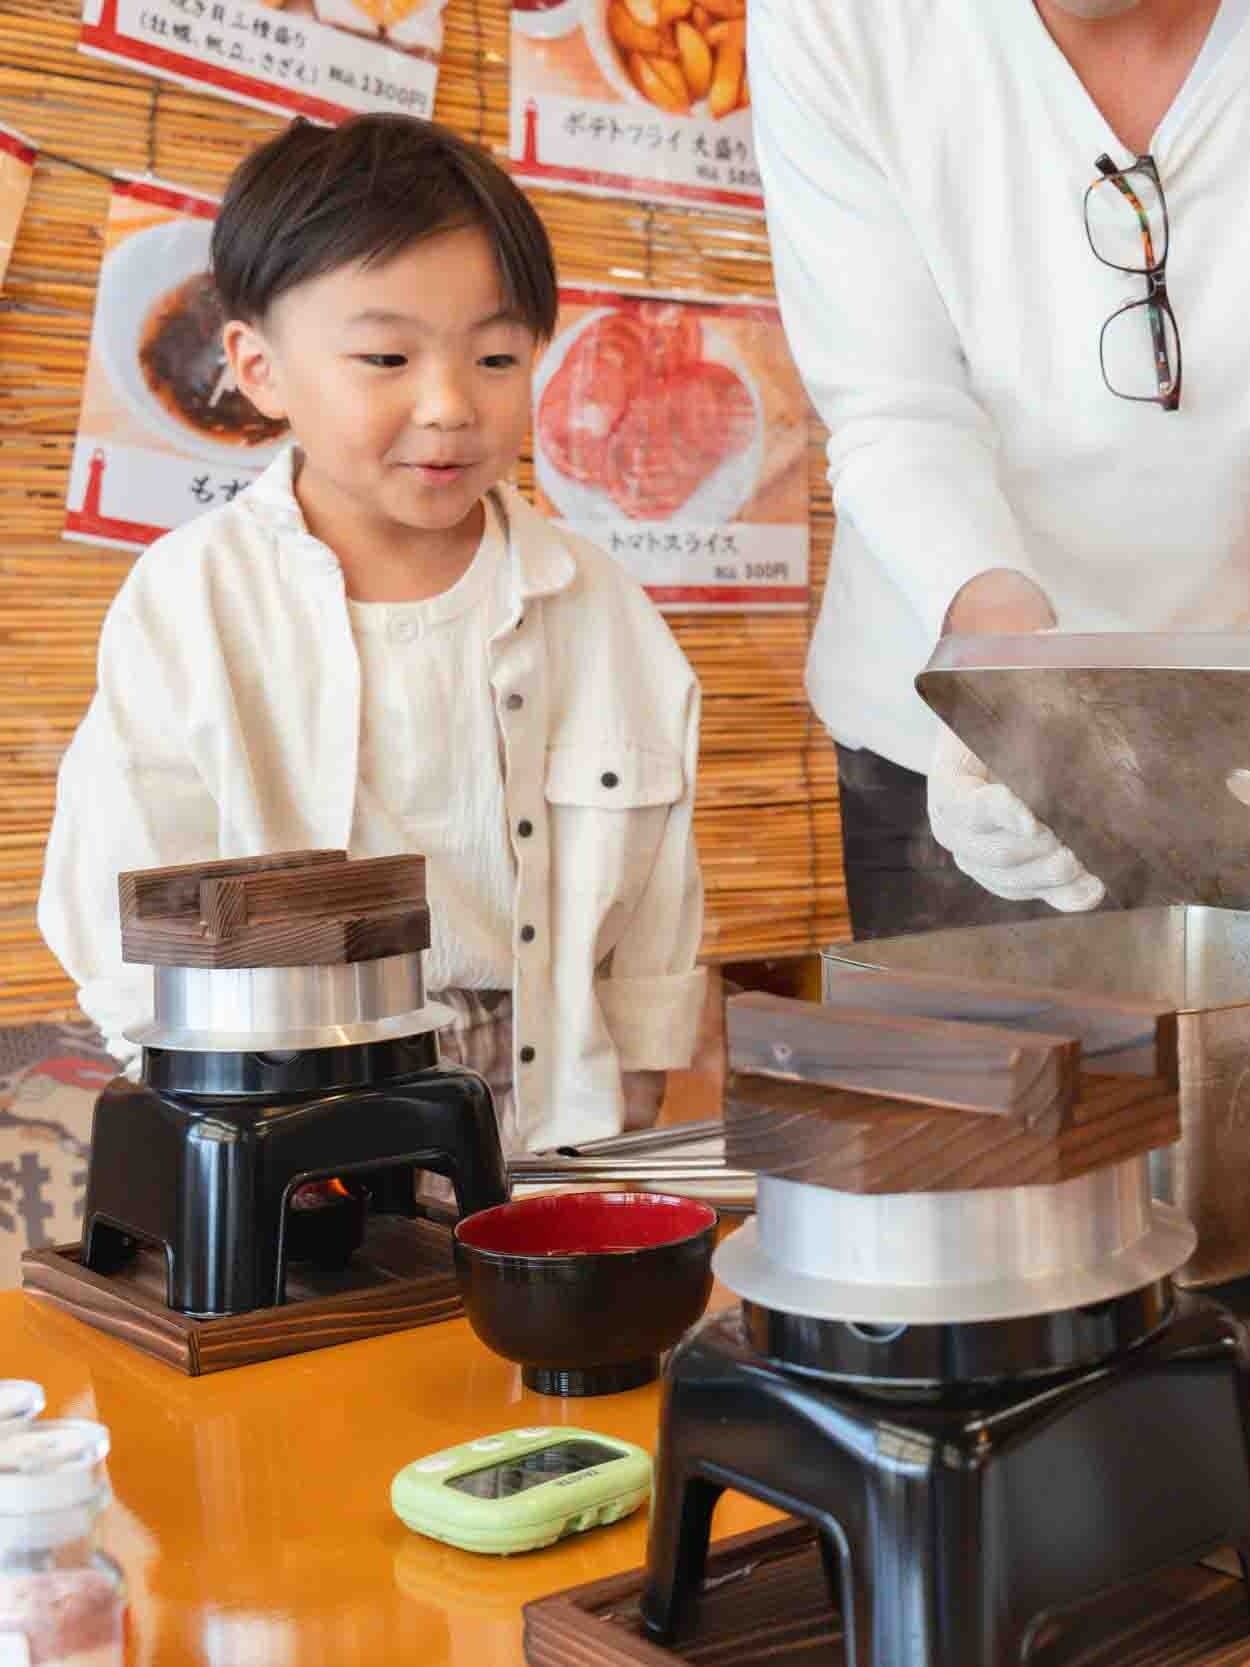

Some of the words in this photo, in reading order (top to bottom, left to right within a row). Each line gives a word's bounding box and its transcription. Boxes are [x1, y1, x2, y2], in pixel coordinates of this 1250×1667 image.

[563, 111, 681, 152] ポテトフライ
[692, 132, 747, 163] 大盛り
[609, 531, 738, 552] トマトスライス
